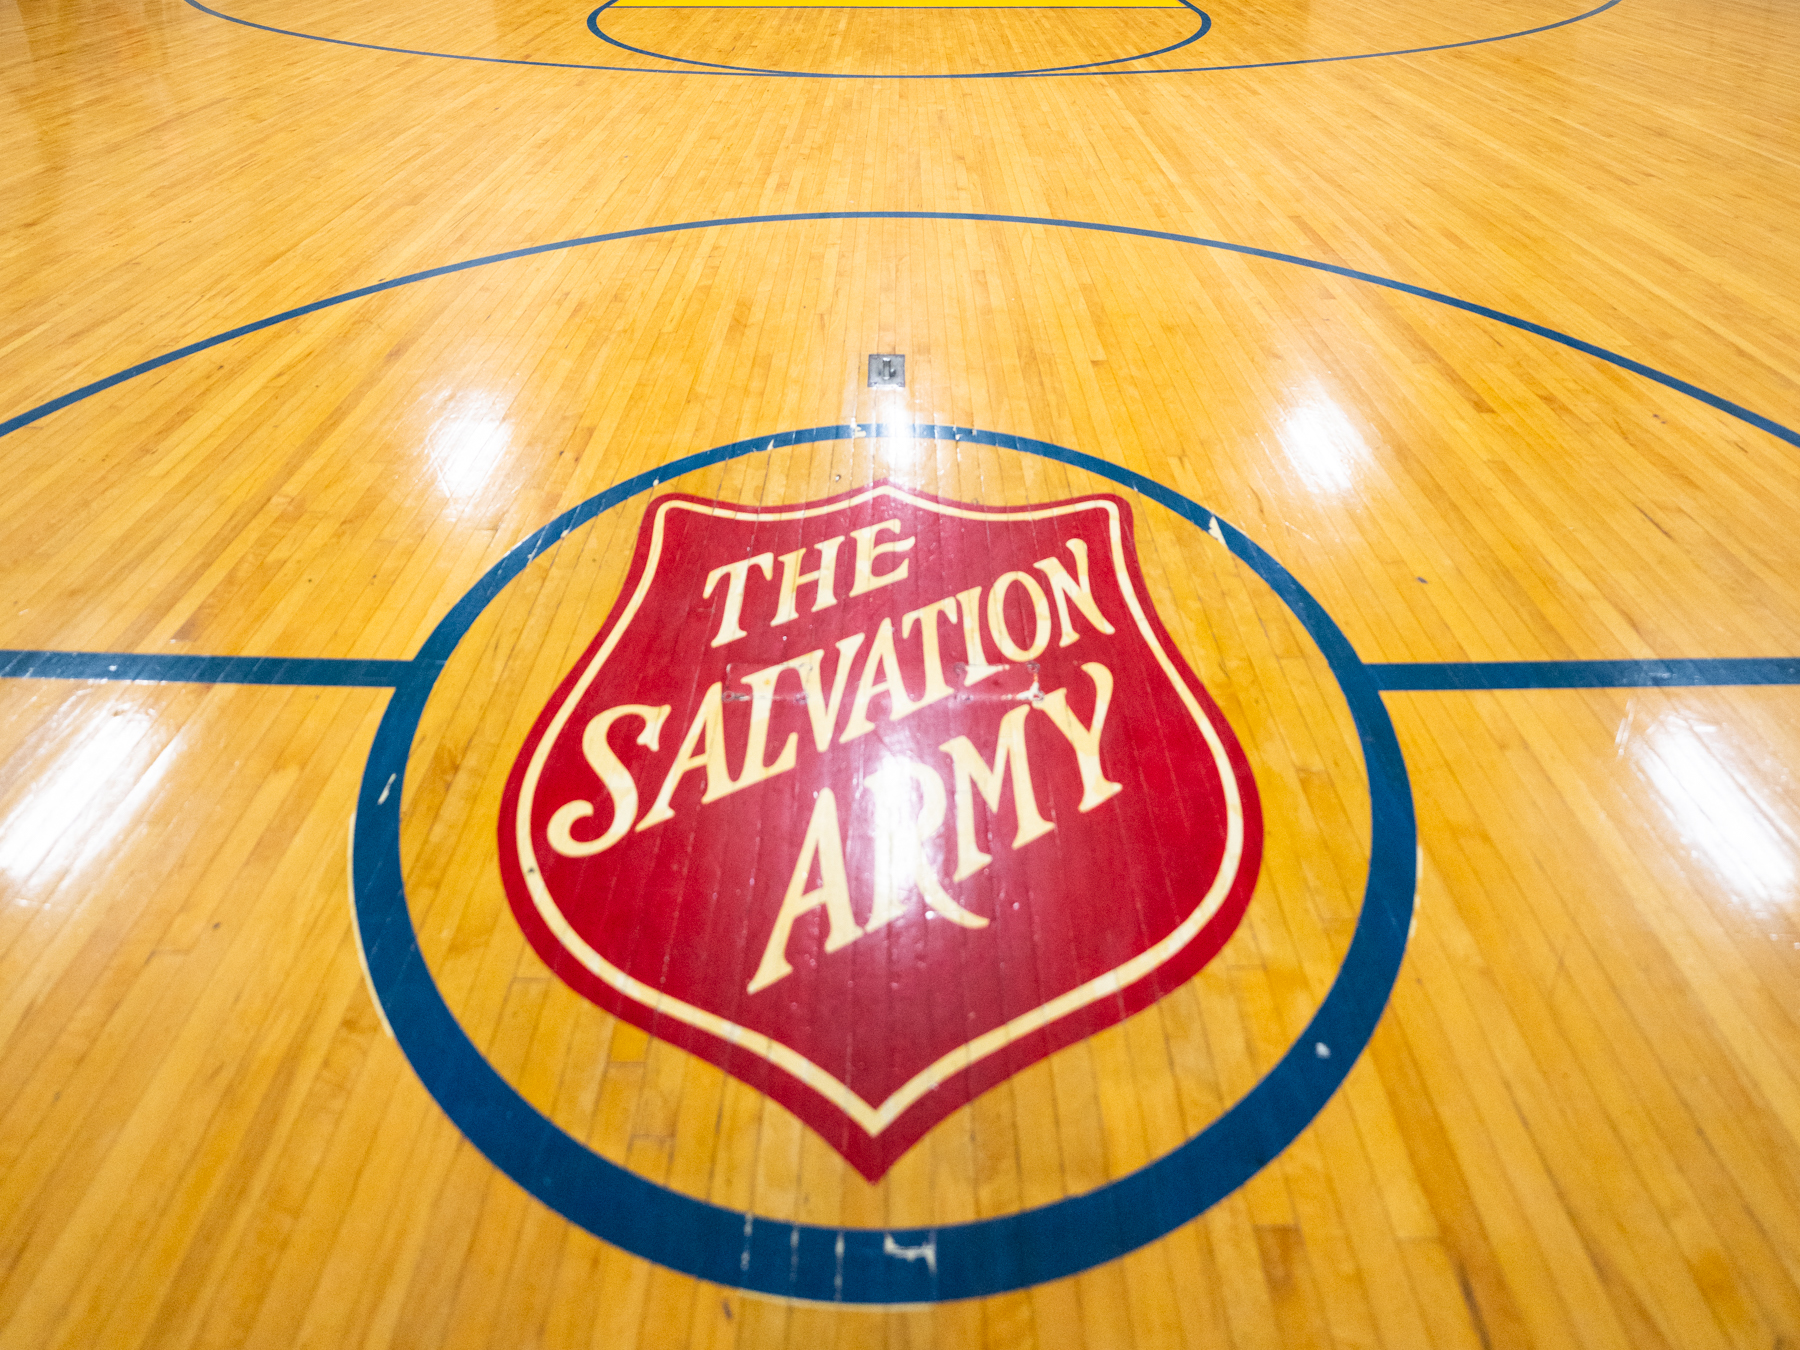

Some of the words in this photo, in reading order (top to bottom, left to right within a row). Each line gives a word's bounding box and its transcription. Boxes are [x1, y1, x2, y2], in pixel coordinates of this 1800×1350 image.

[546, 538, 1116, 858] SALVATION
[702, 518, 917, 648] THE
[746, 661, 1124, 996] ARMY
